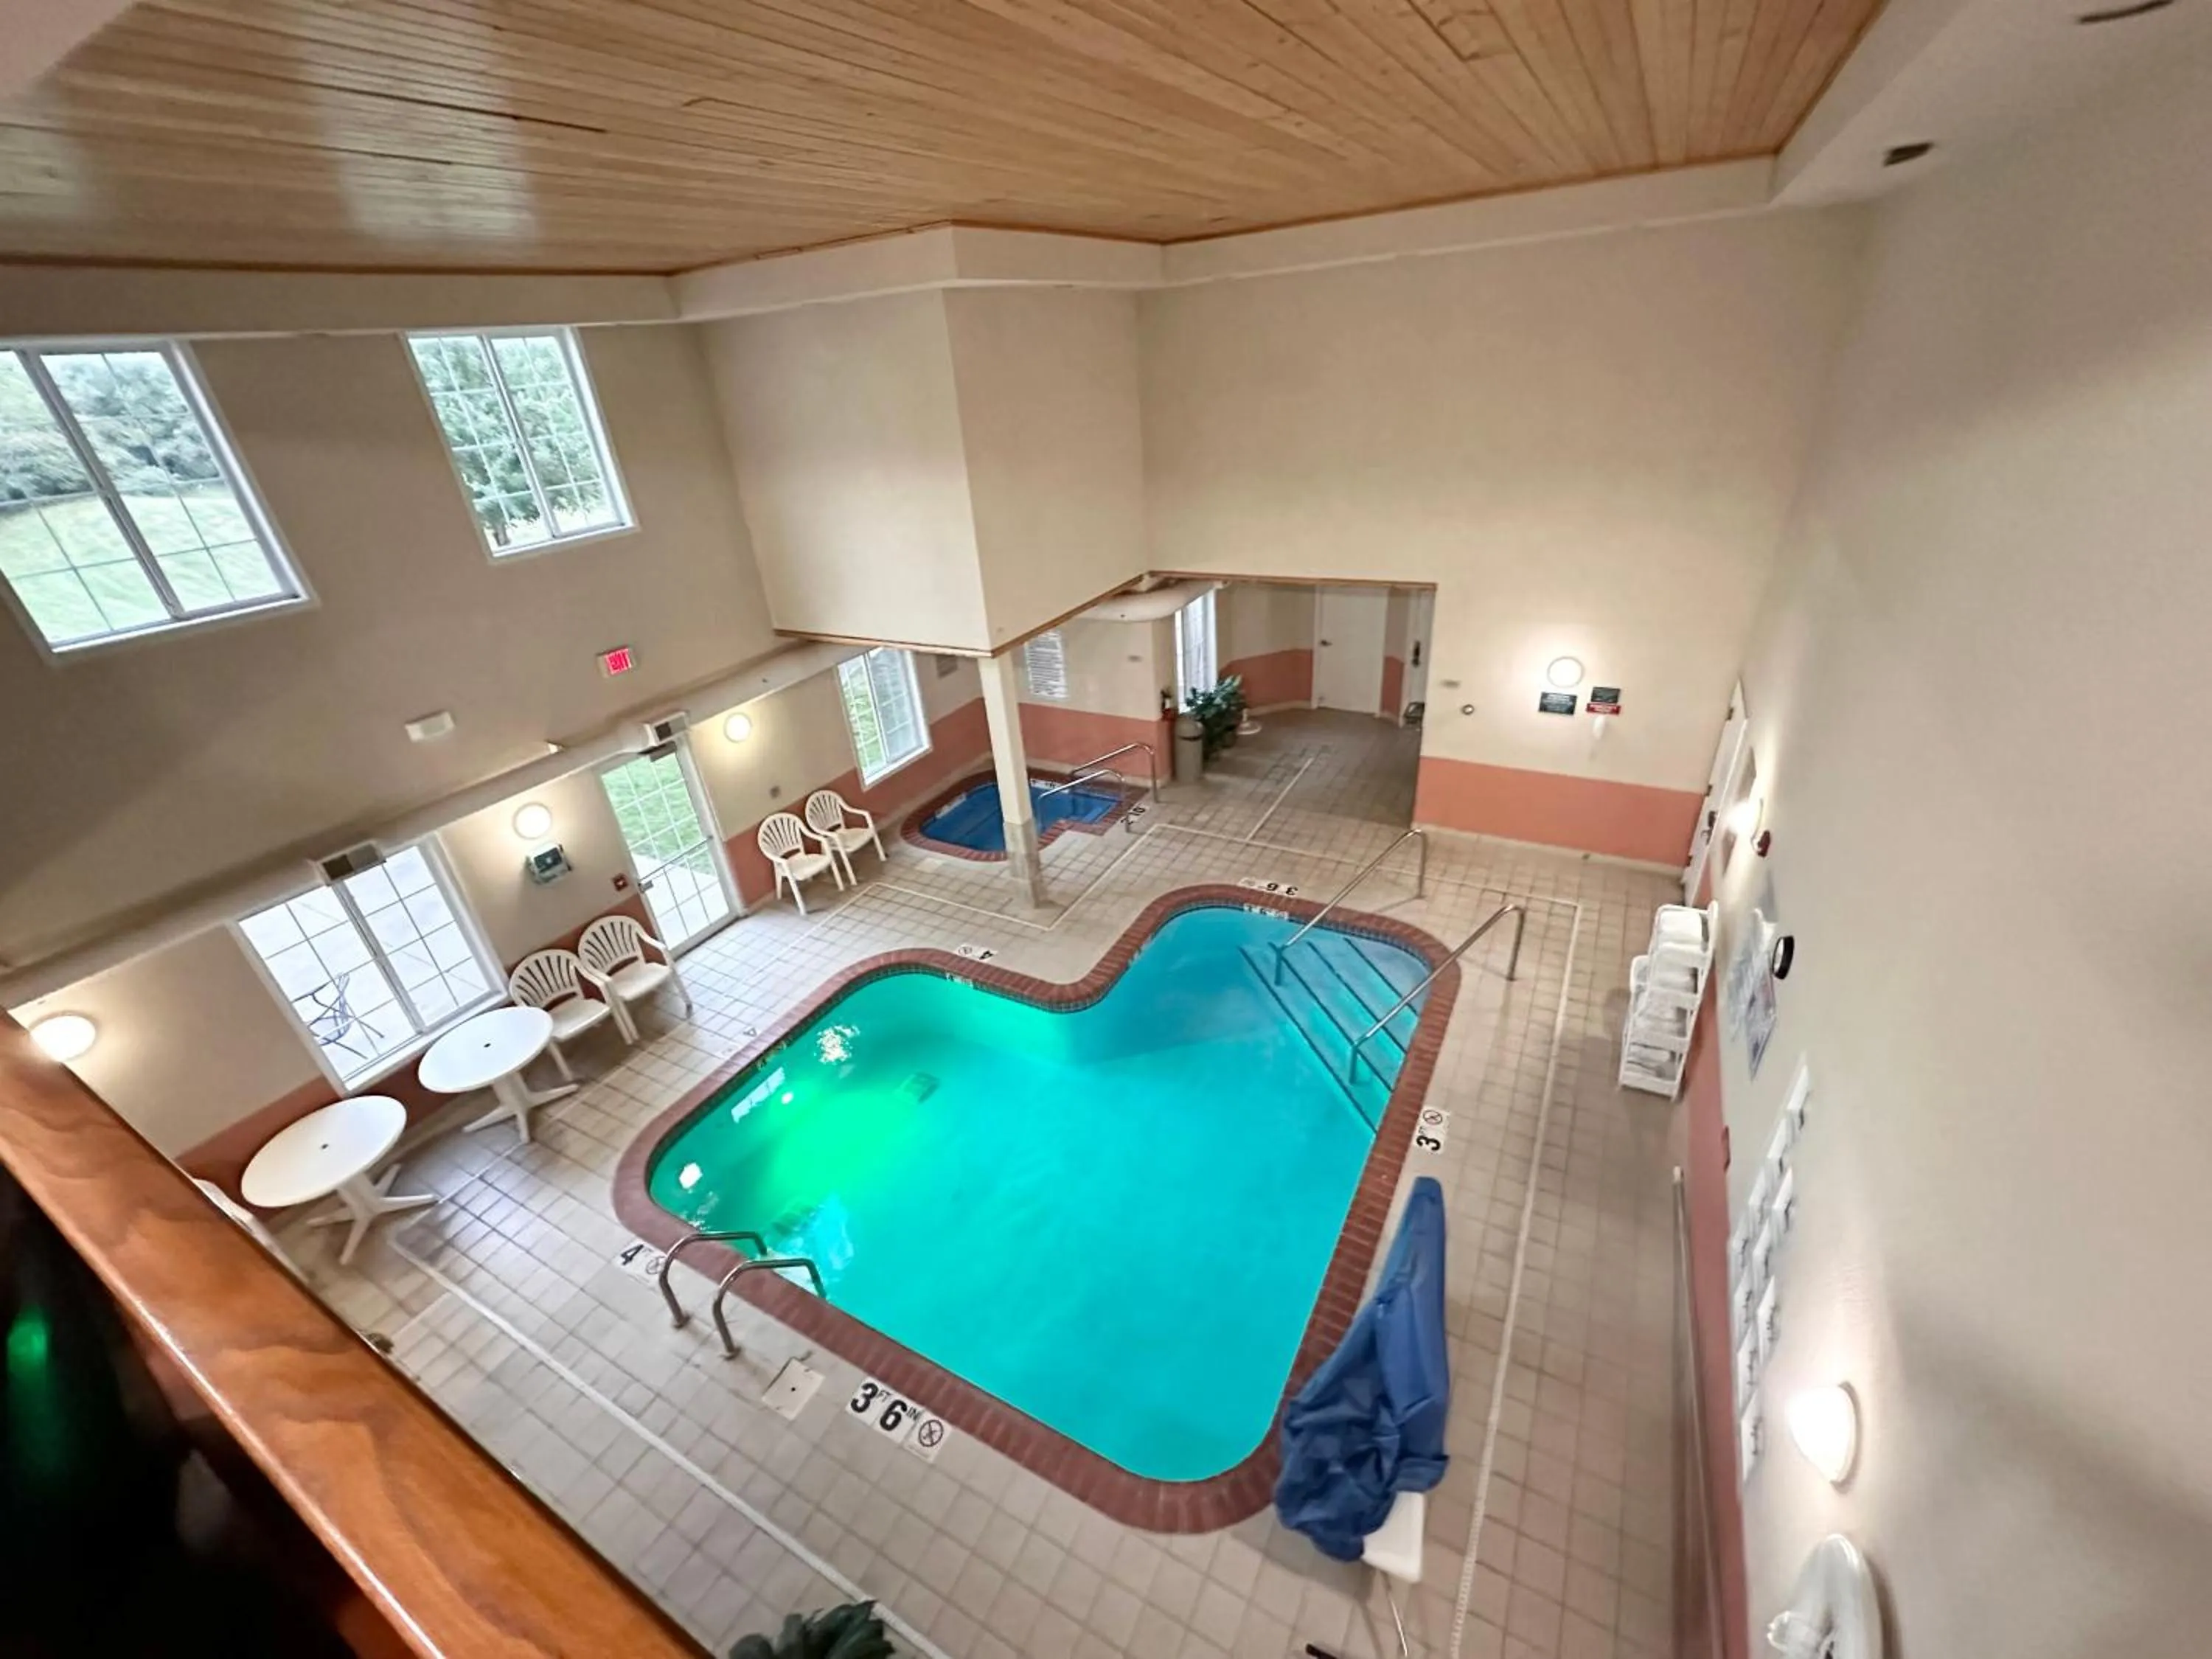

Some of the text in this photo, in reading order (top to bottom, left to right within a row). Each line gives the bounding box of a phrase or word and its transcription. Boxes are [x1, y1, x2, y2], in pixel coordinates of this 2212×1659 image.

[1285, 887, 1298, 896] 3
[1416, 1135, 1441, 1152] 3
[620, 1244, 644, 1266] 4
